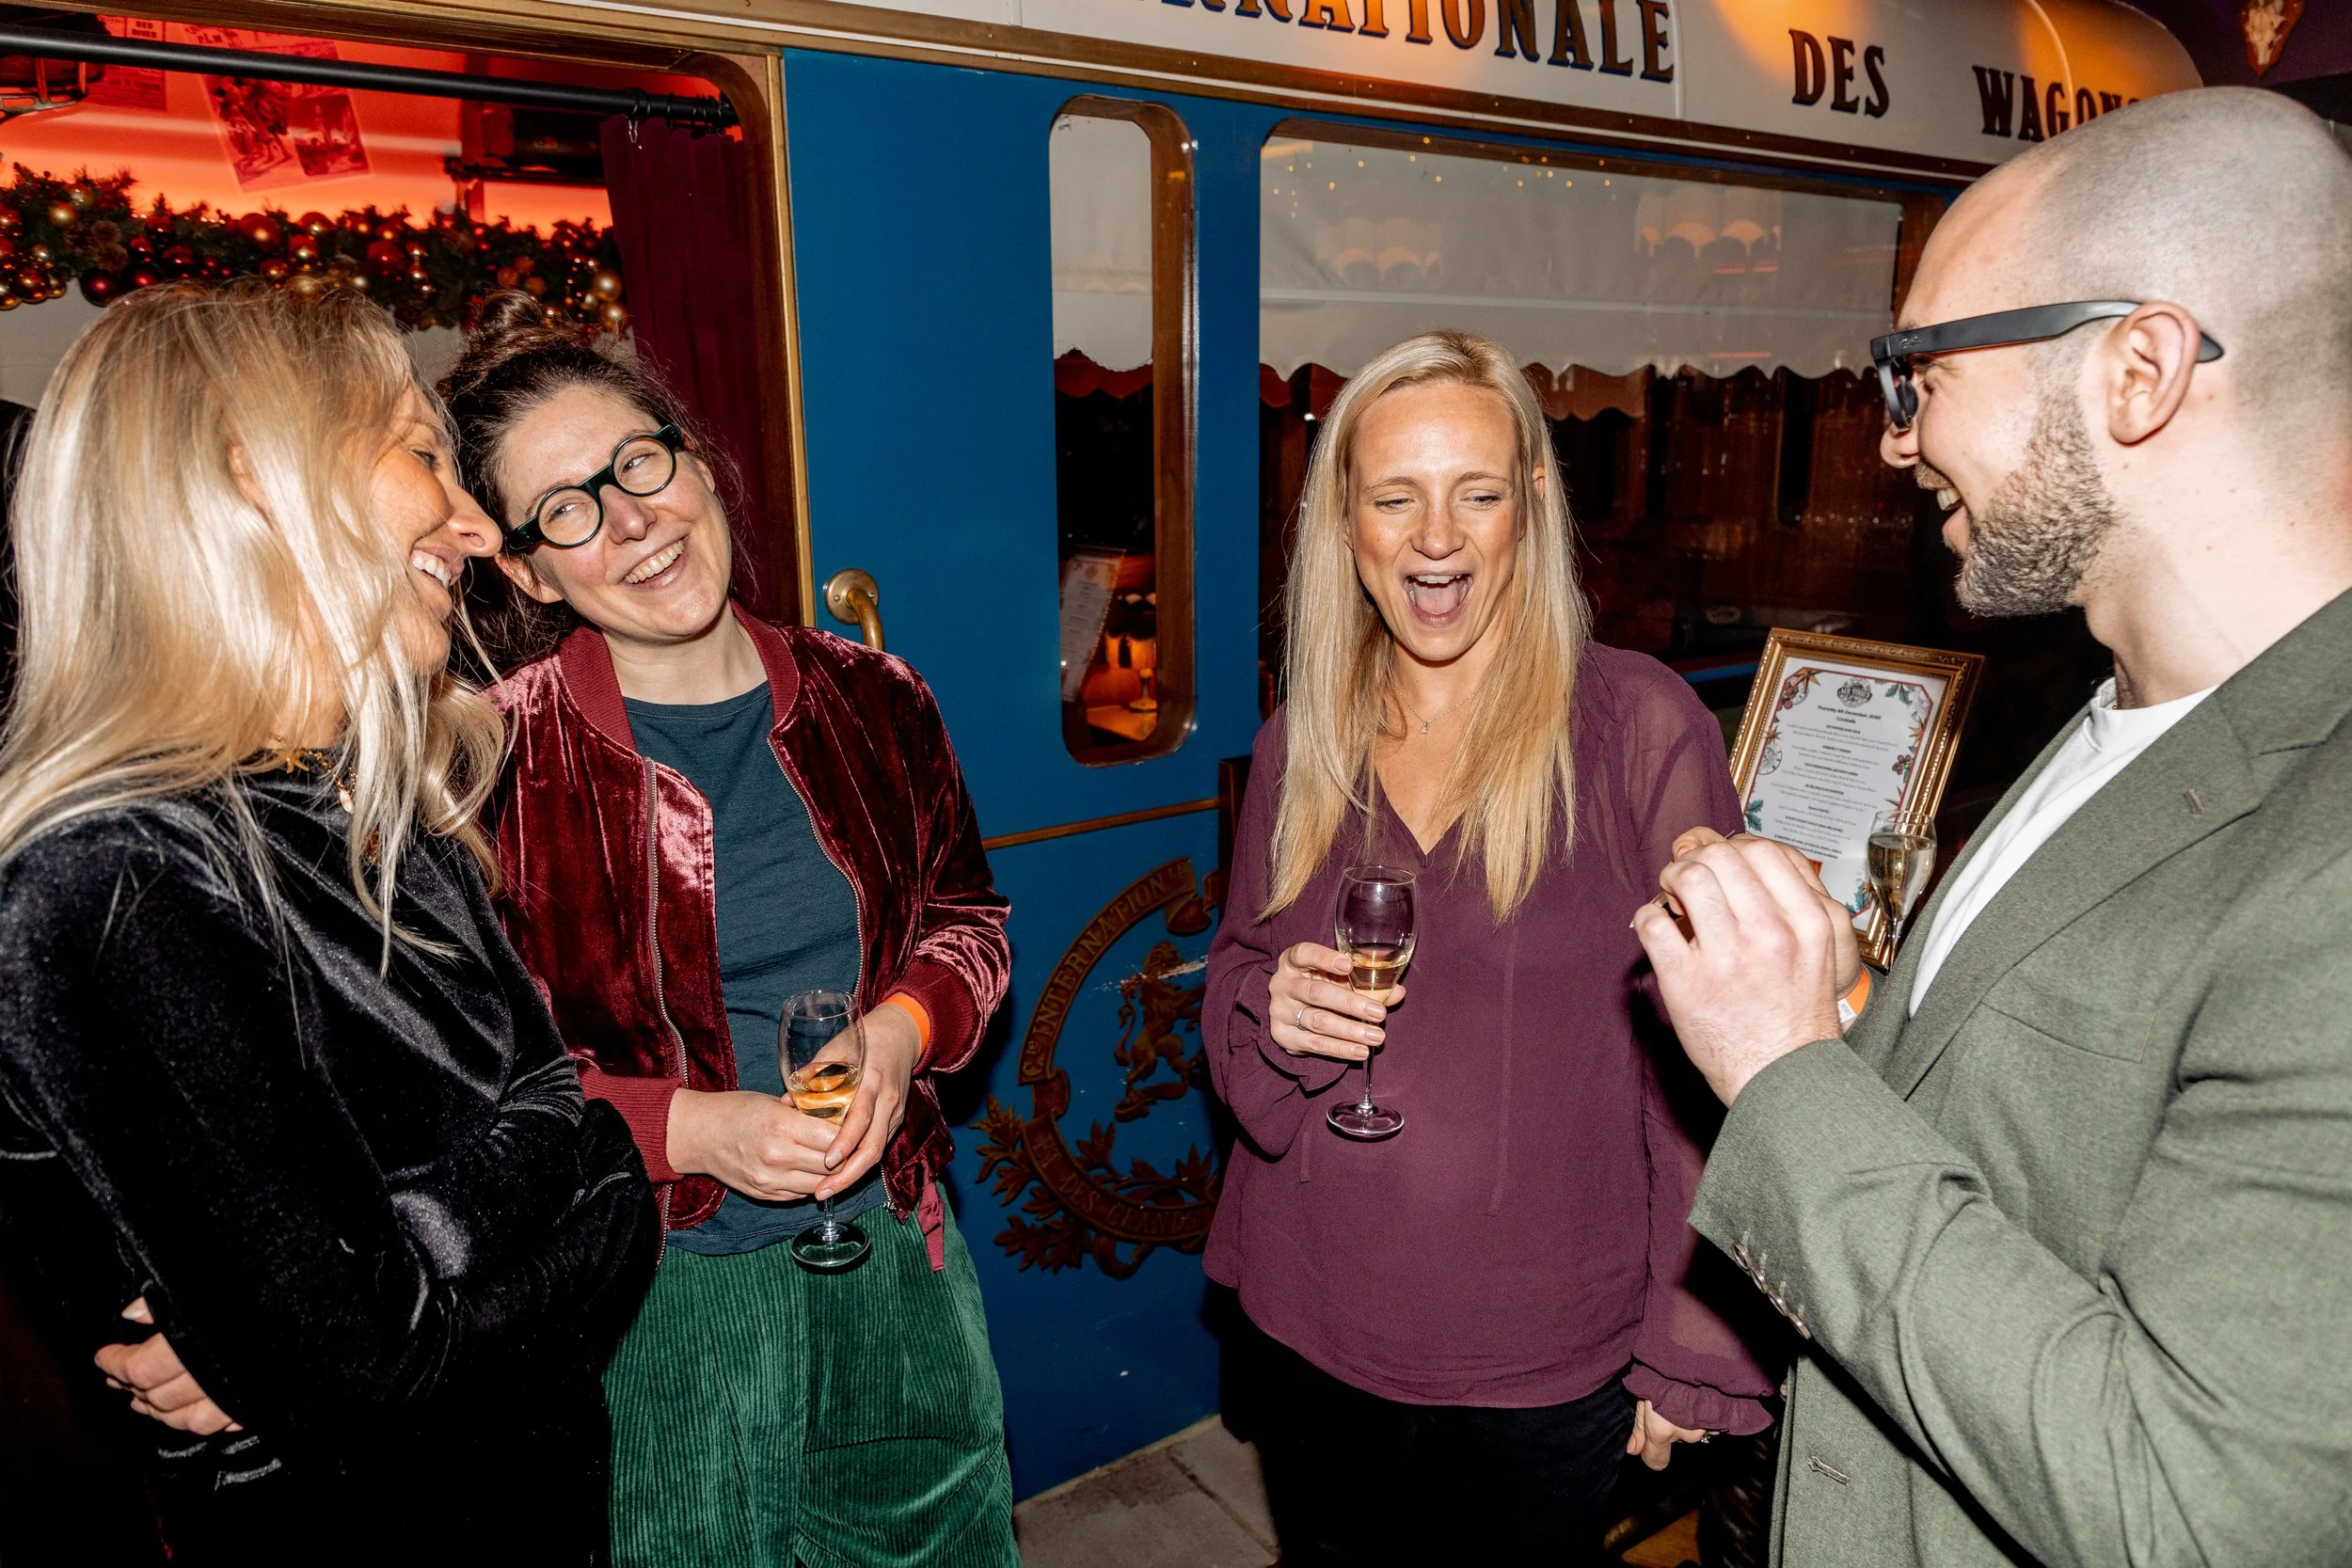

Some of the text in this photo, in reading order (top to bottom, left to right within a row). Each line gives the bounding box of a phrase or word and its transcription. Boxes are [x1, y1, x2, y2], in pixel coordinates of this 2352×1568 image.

[1788, 28, 1890, 119] DES
[1972, 65, 2141, 143] WAGO
[1059, 1172, 1101, 1212] DES
[1106, 1204, 1198, 1235] GRANDS
